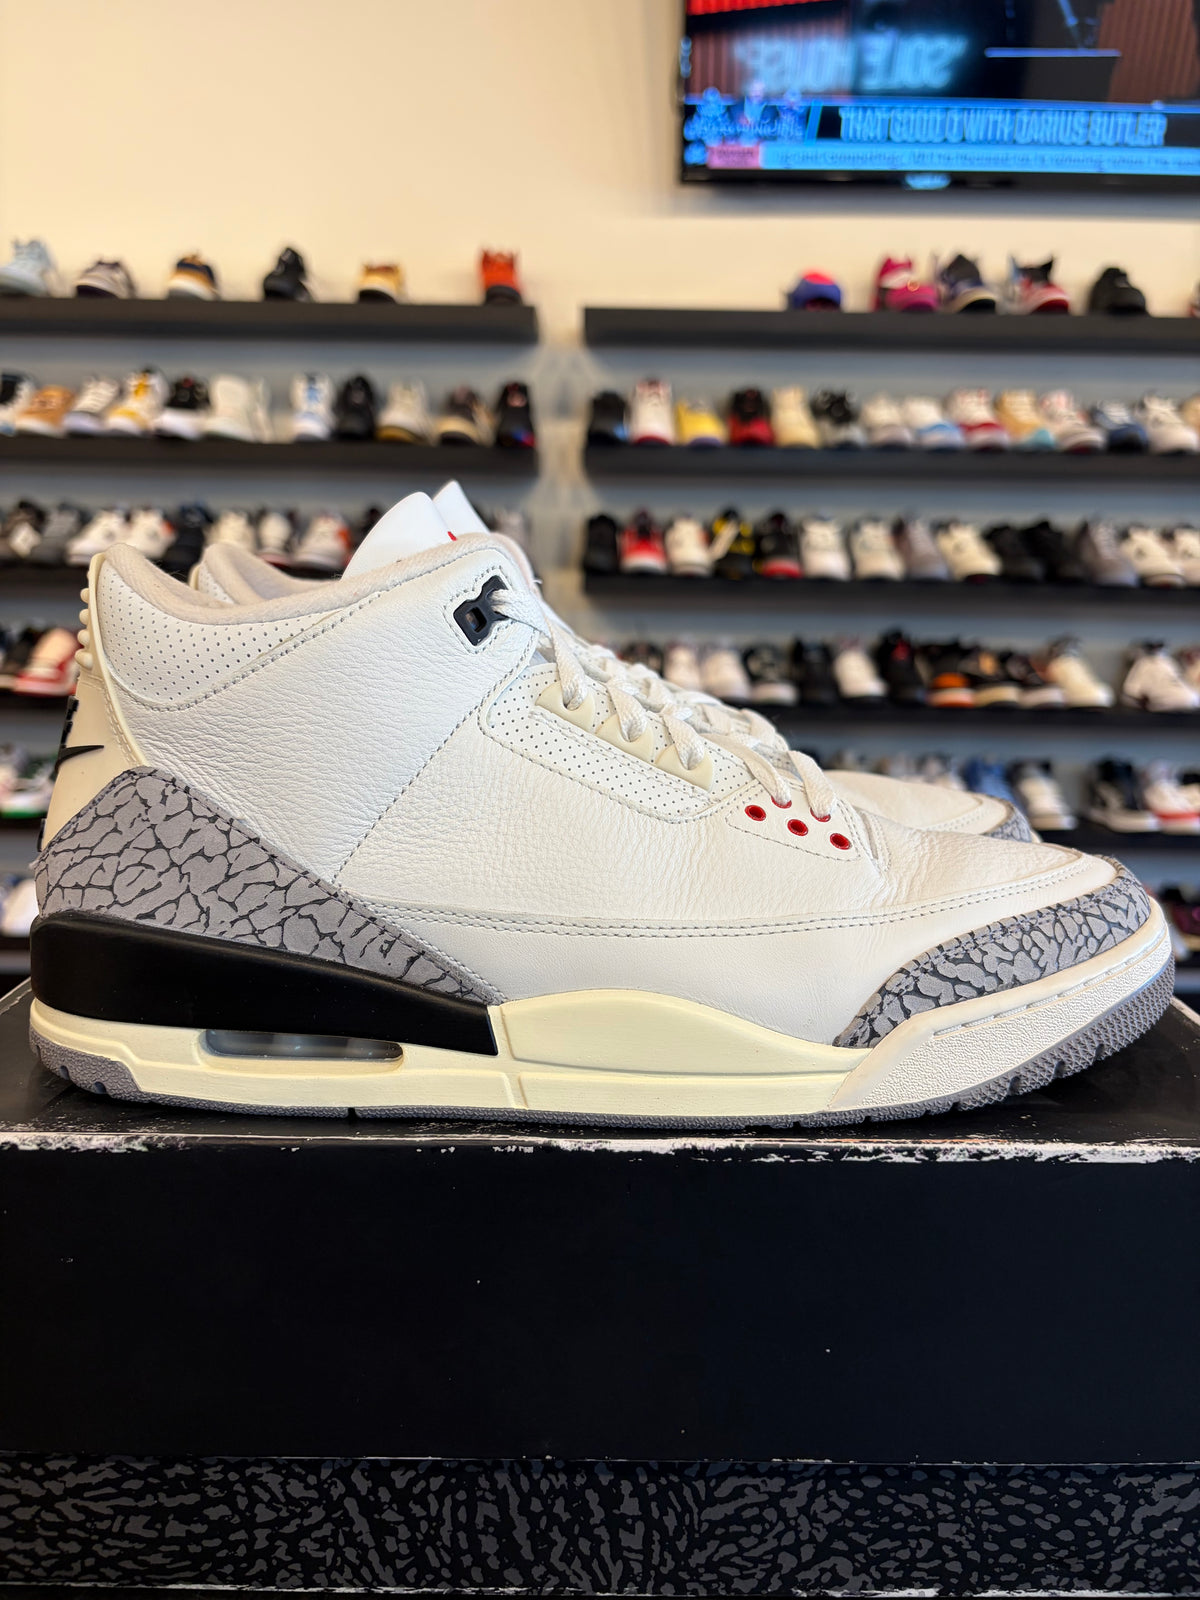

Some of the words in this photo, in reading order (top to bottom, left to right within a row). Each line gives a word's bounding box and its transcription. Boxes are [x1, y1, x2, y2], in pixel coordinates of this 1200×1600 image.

[838, 107, 888, 142] THAT
[963, 108, 1015, 144] WITH
[1014, 109, 1089, 146] DARIUS
[1089, 111, 1168, 147] BUTLER
